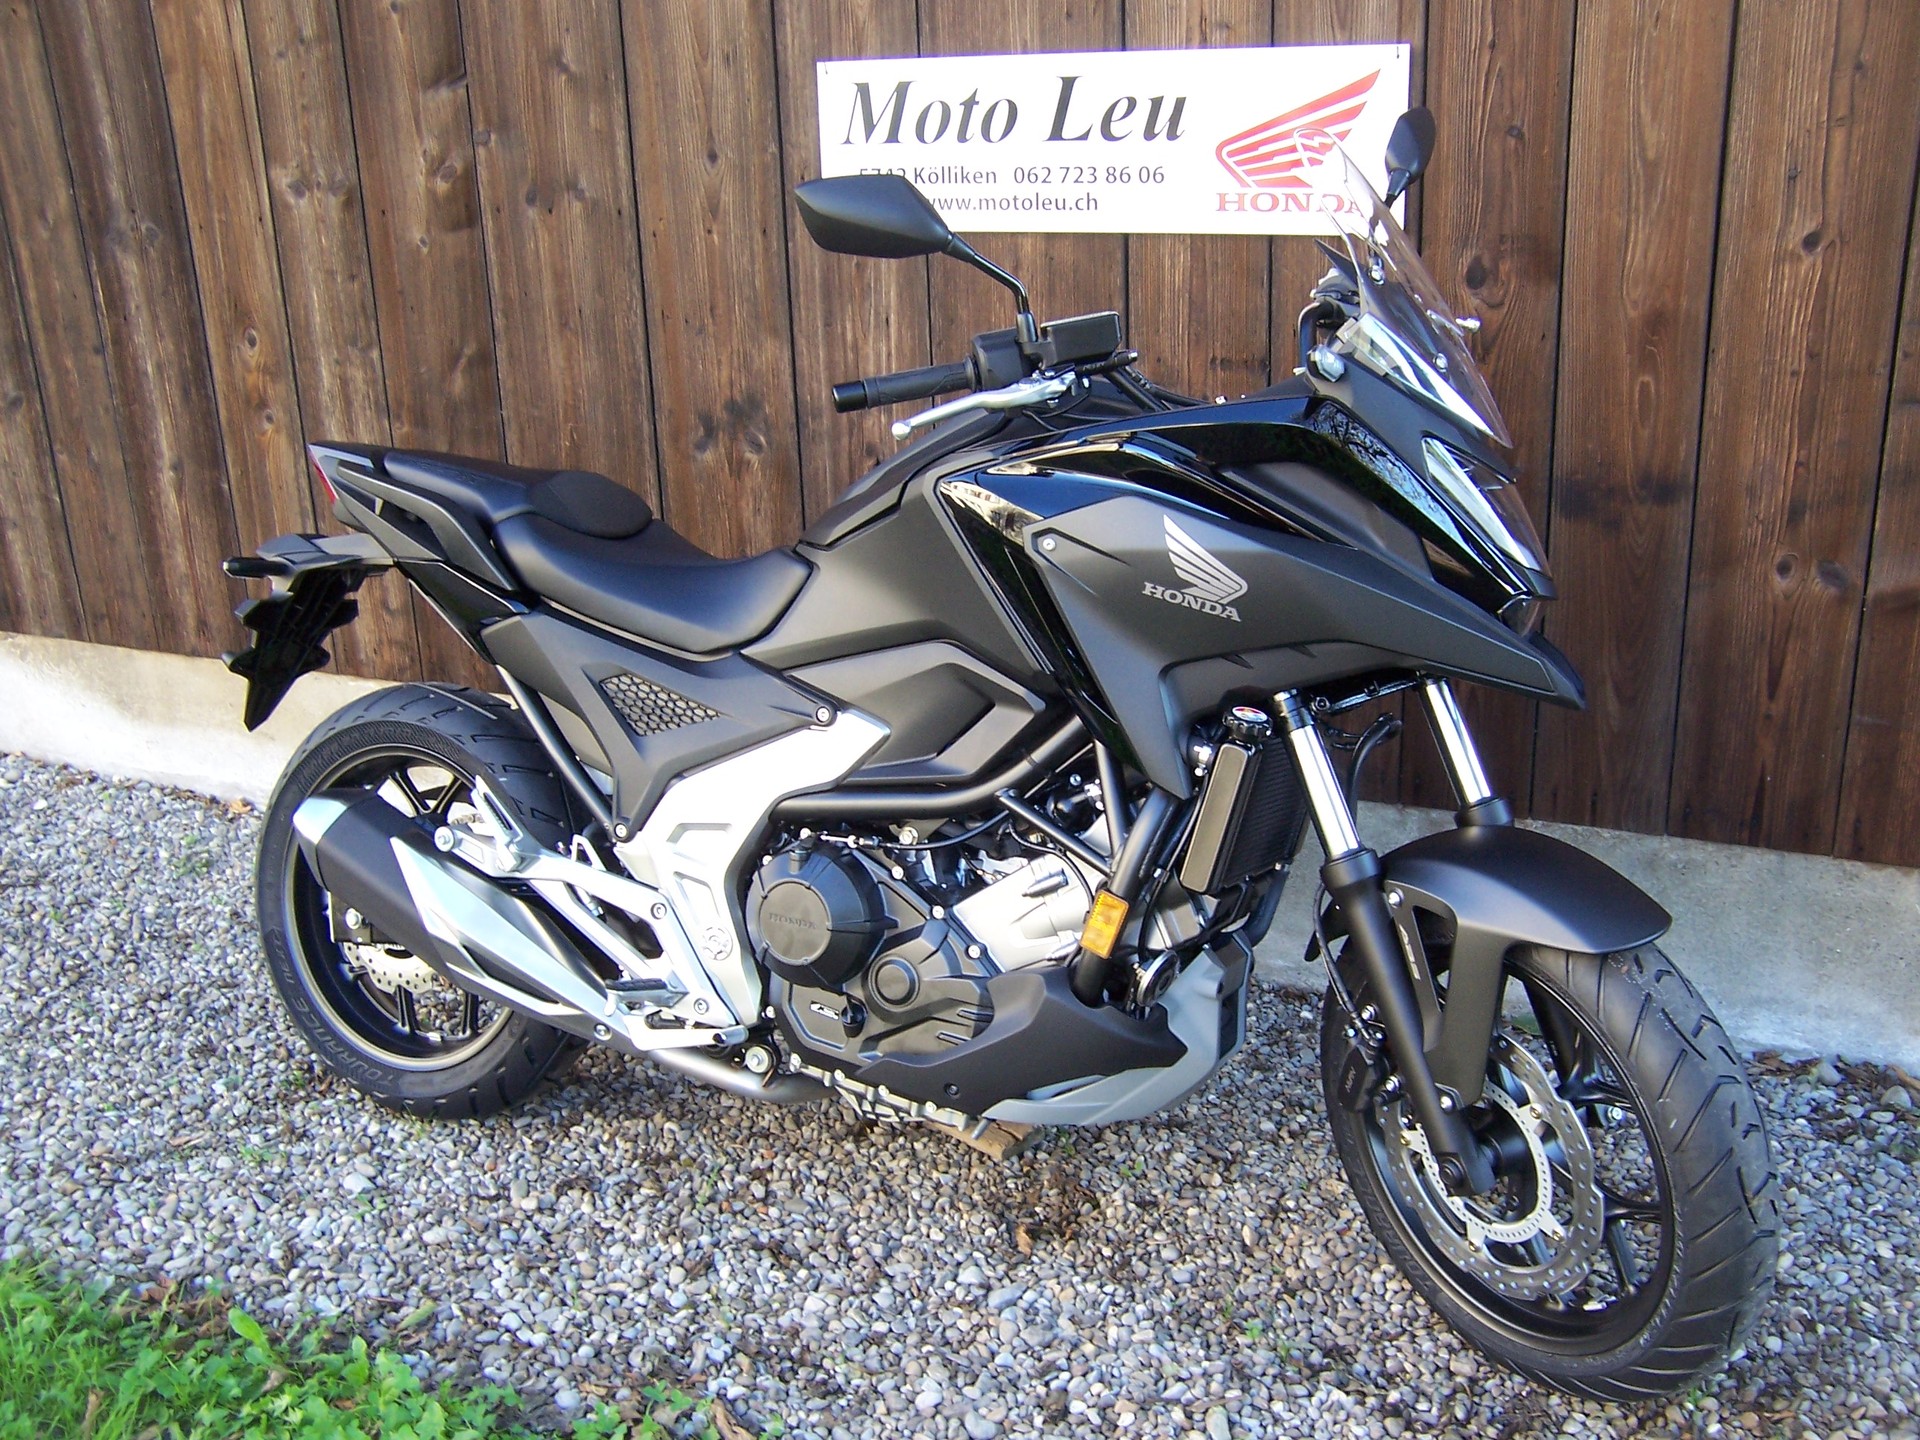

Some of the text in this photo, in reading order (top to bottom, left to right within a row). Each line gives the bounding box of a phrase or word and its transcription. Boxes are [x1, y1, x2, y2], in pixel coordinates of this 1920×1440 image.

[840, 75, 1187, 145] Moto Leu
[914, 165, 998, 185] Kölliken
[1013, 166, 1052, 184] 062
[1058, 166, 1098, 184] 723
[1105, 165, 1132, 184] 86
[1138, 165, 1166, 184] 06
[1142, 581, 1242, 622] HONDA
